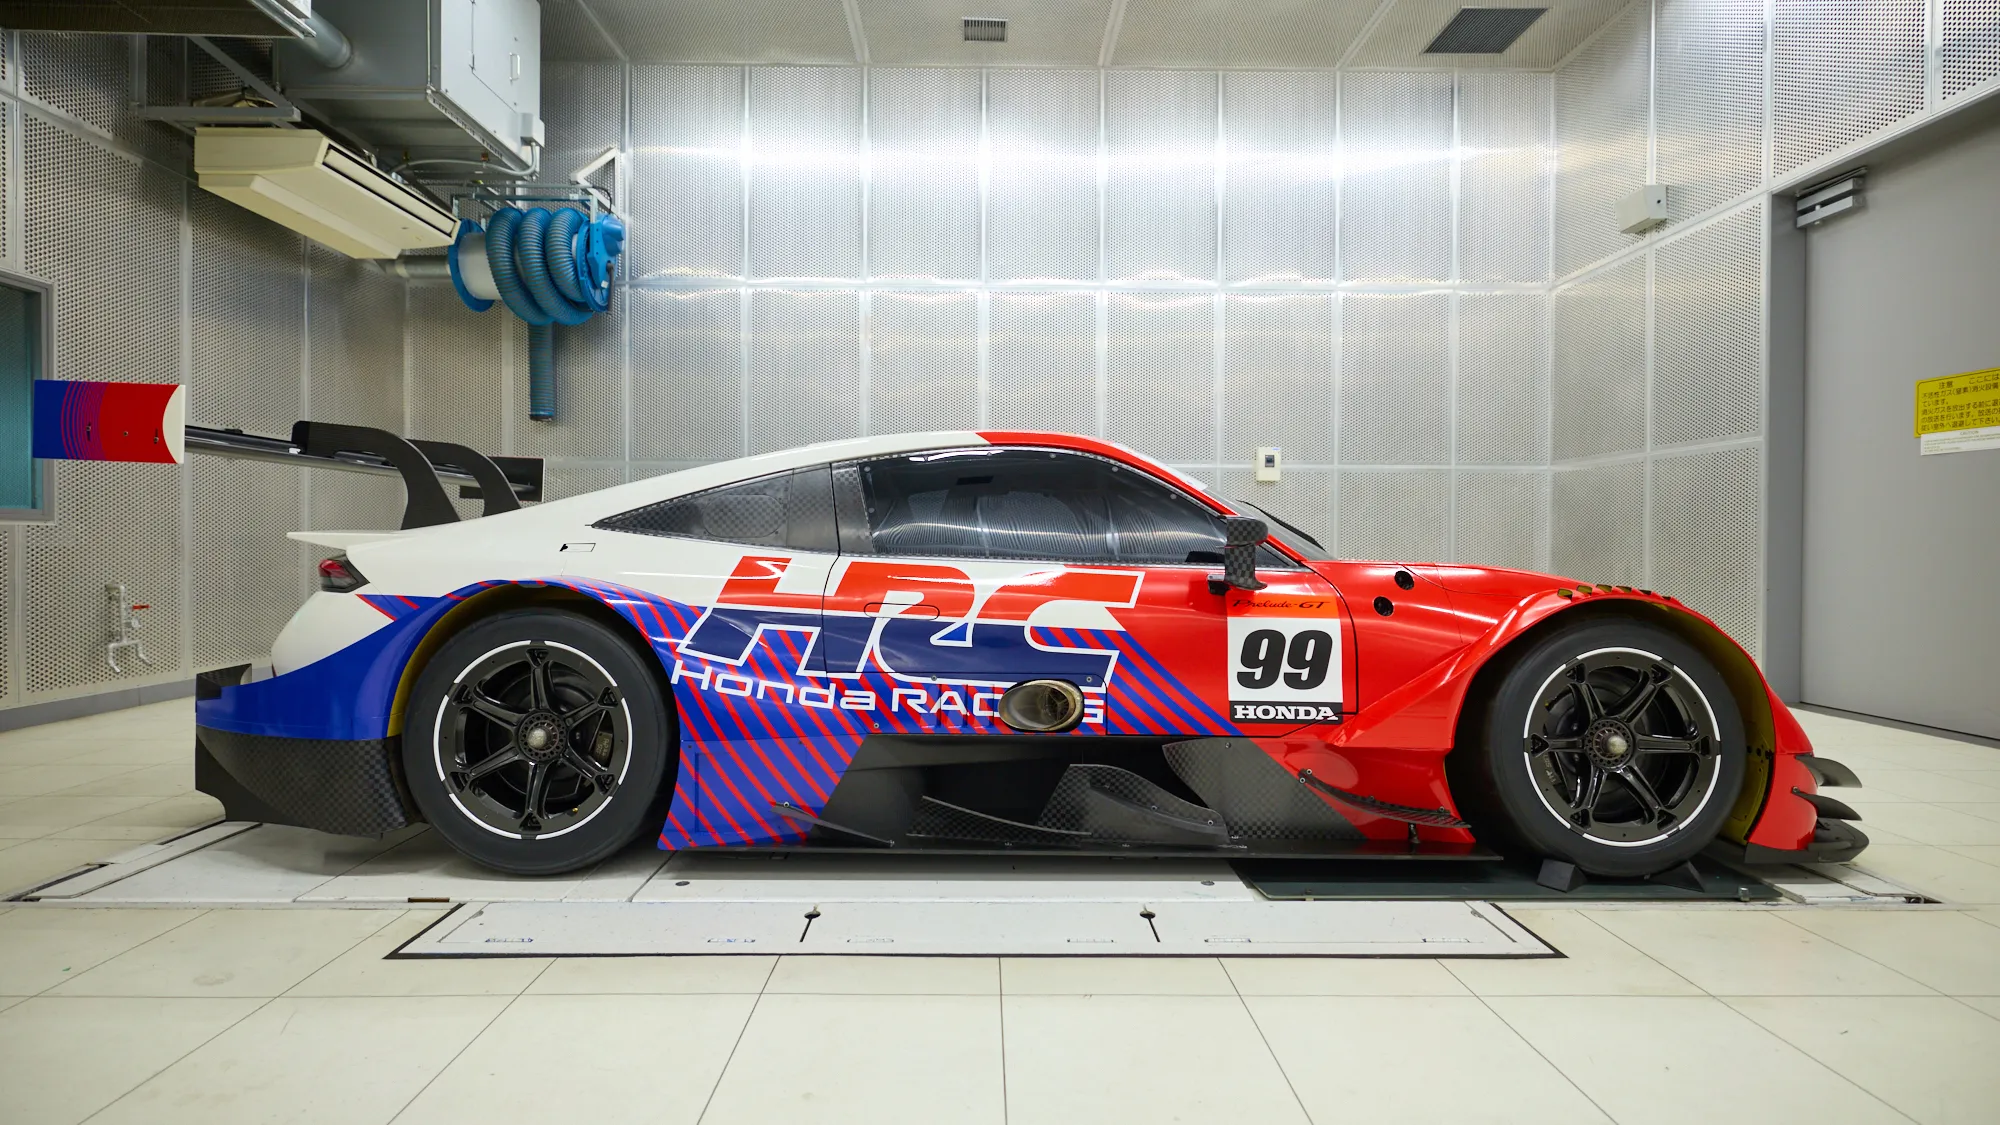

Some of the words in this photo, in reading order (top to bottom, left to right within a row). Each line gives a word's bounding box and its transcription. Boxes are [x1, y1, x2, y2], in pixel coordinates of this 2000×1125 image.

[1236, 629, 1334, 690] 99
[670, 659, 876, 711] Honda
[891, 687, 1104, 724] RACG
[1234, 705, 1339, 721] HONDA
